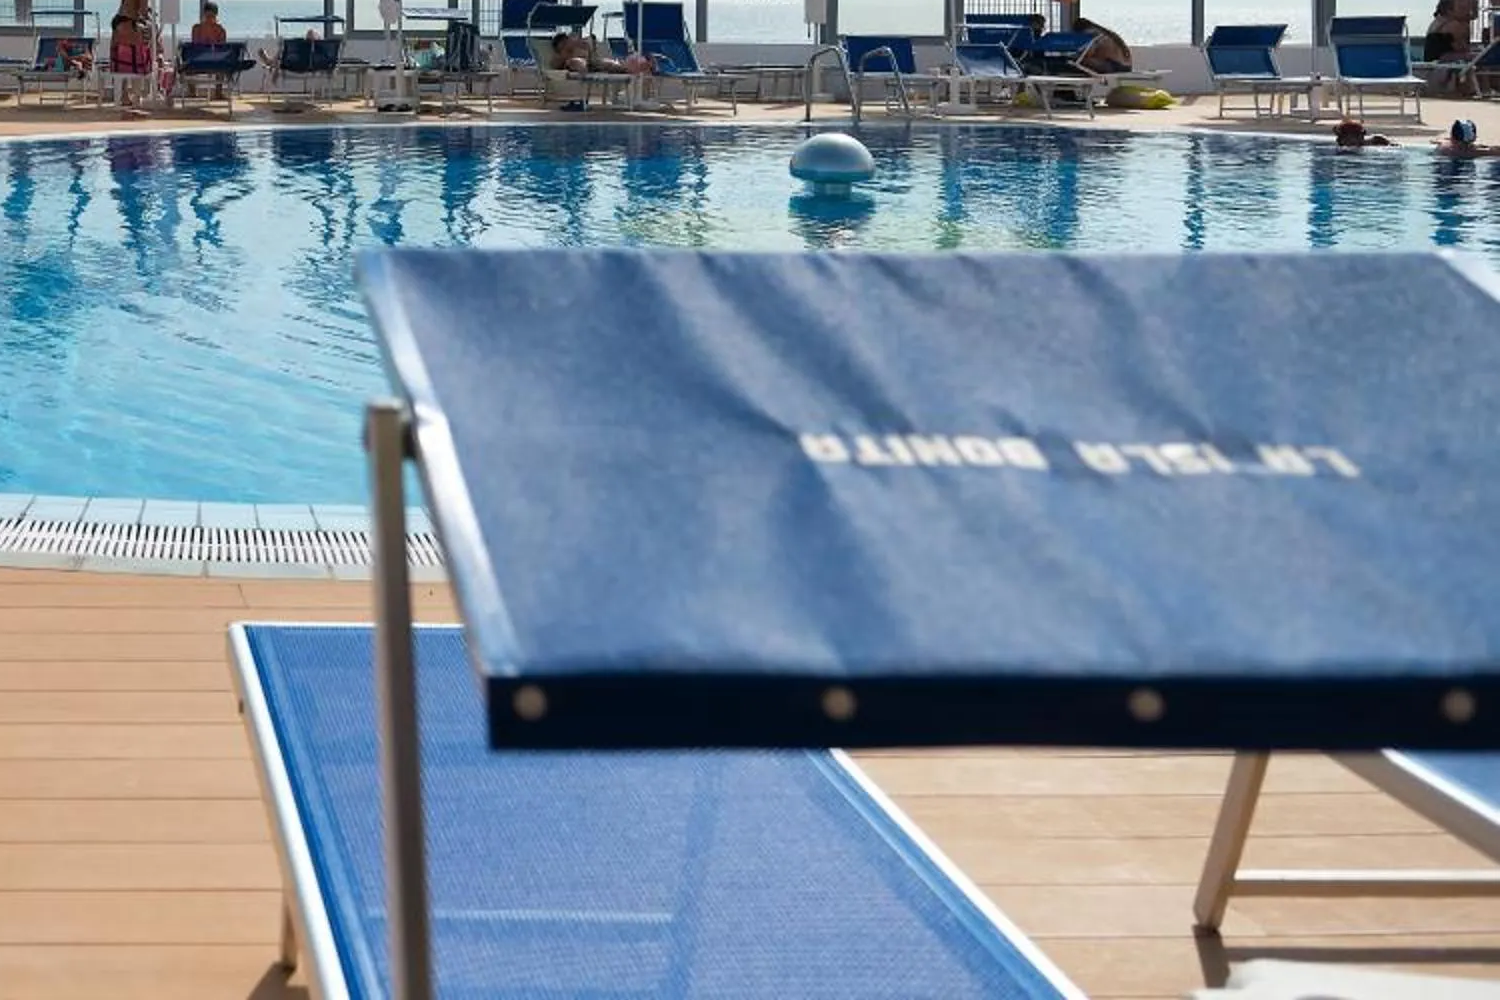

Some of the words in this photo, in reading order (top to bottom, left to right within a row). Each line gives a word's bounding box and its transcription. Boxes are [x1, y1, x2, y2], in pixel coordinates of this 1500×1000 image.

[800, 431, 1050, 470] BONITA
[1073, 440, 1236, 475] ISLA
[1255, 442, 1361, 478] LA
